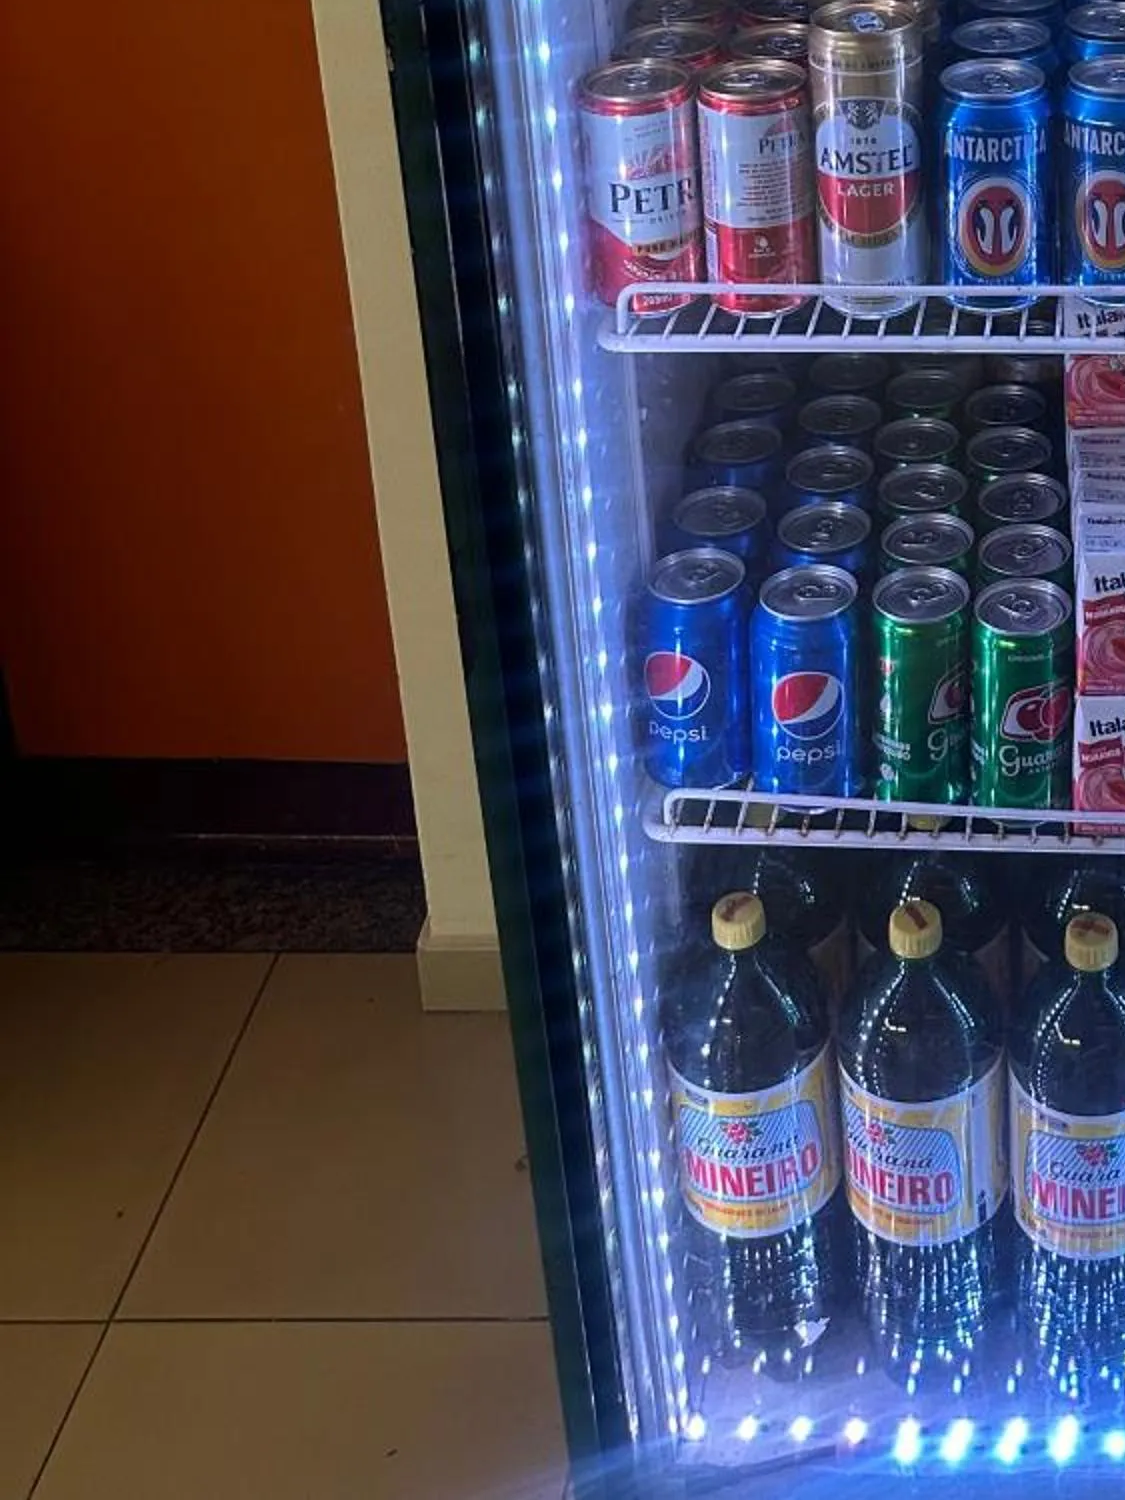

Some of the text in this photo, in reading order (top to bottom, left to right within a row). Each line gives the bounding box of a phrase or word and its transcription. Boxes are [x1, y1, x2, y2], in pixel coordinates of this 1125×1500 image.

[820, 143, 913, 176] AMSTEL
[836, 181, 895, 197] LAGER
[682, 1141, 820, 1198] MINEIRO
